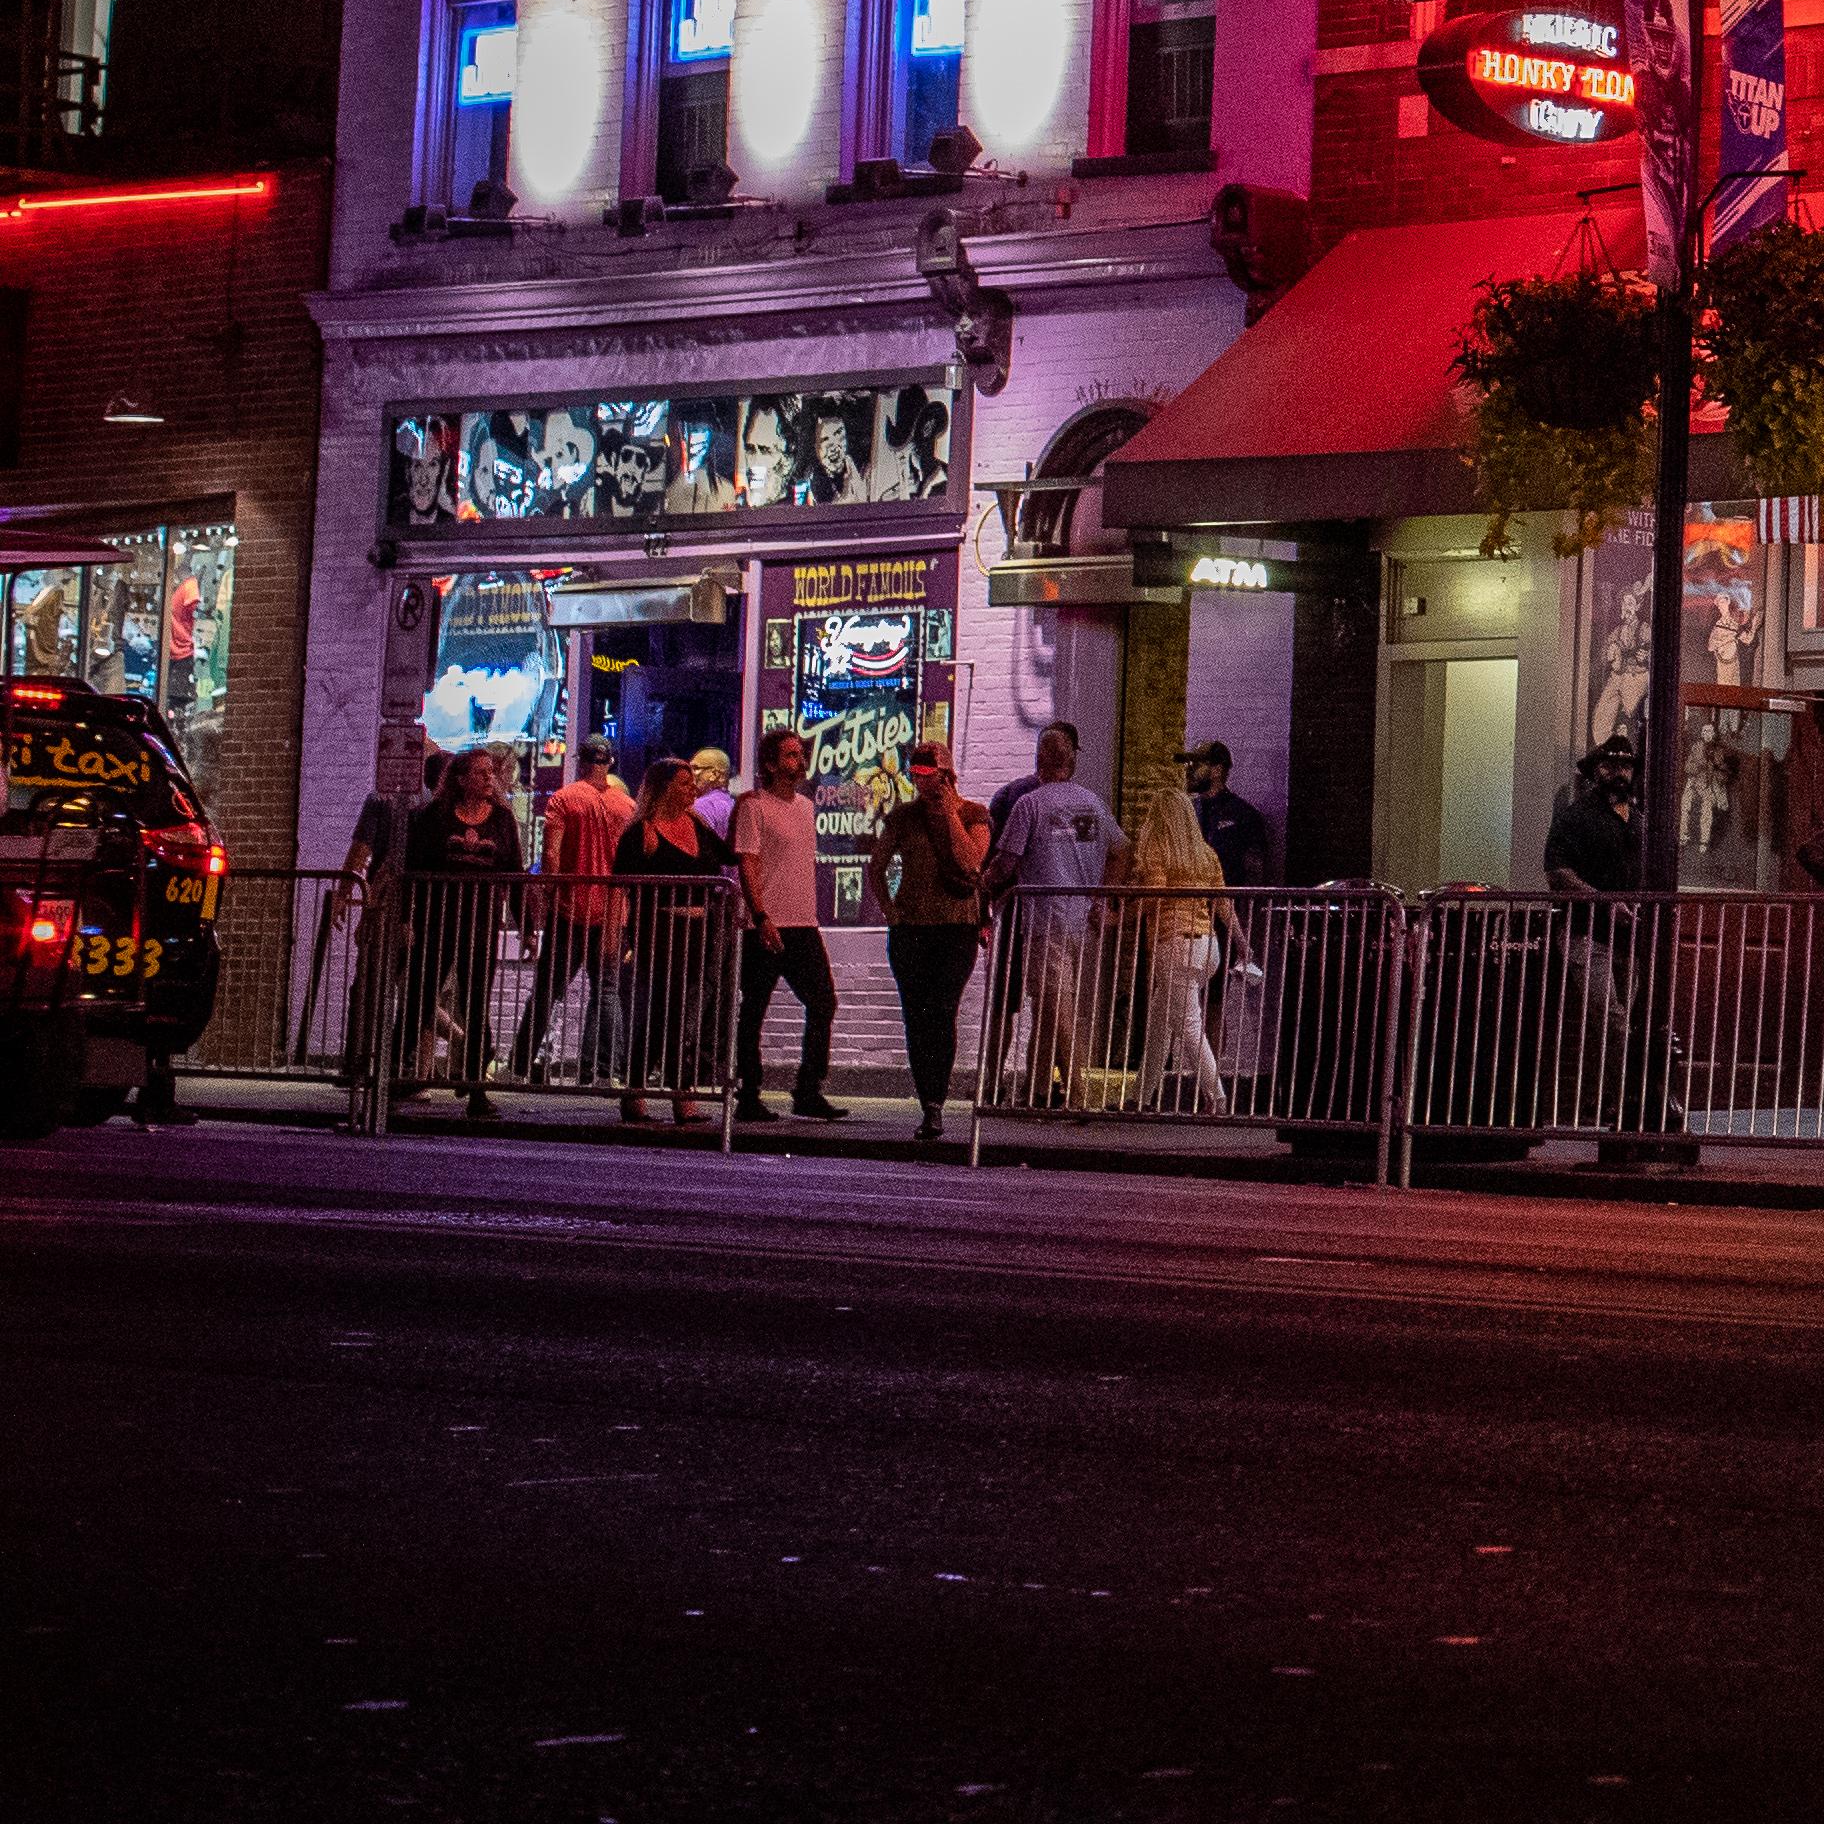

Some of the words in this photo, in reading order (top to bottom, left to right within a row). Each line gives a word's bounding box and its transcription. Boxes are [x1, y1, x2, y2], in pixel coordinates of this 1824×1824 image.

[1480, 49, 1576, 91] HONKY
[1729, 69, 1784, 111] TITAN
[1752, 114, 1780, 139] UP
[793, 564, 853, 607] WORLD
[855, 560, 927, 604] FAMOUS
[46, 737, 151, 785] taxi
[799, 706, 914, 780] Tootsies
[165, 876, 203, 904] 620
